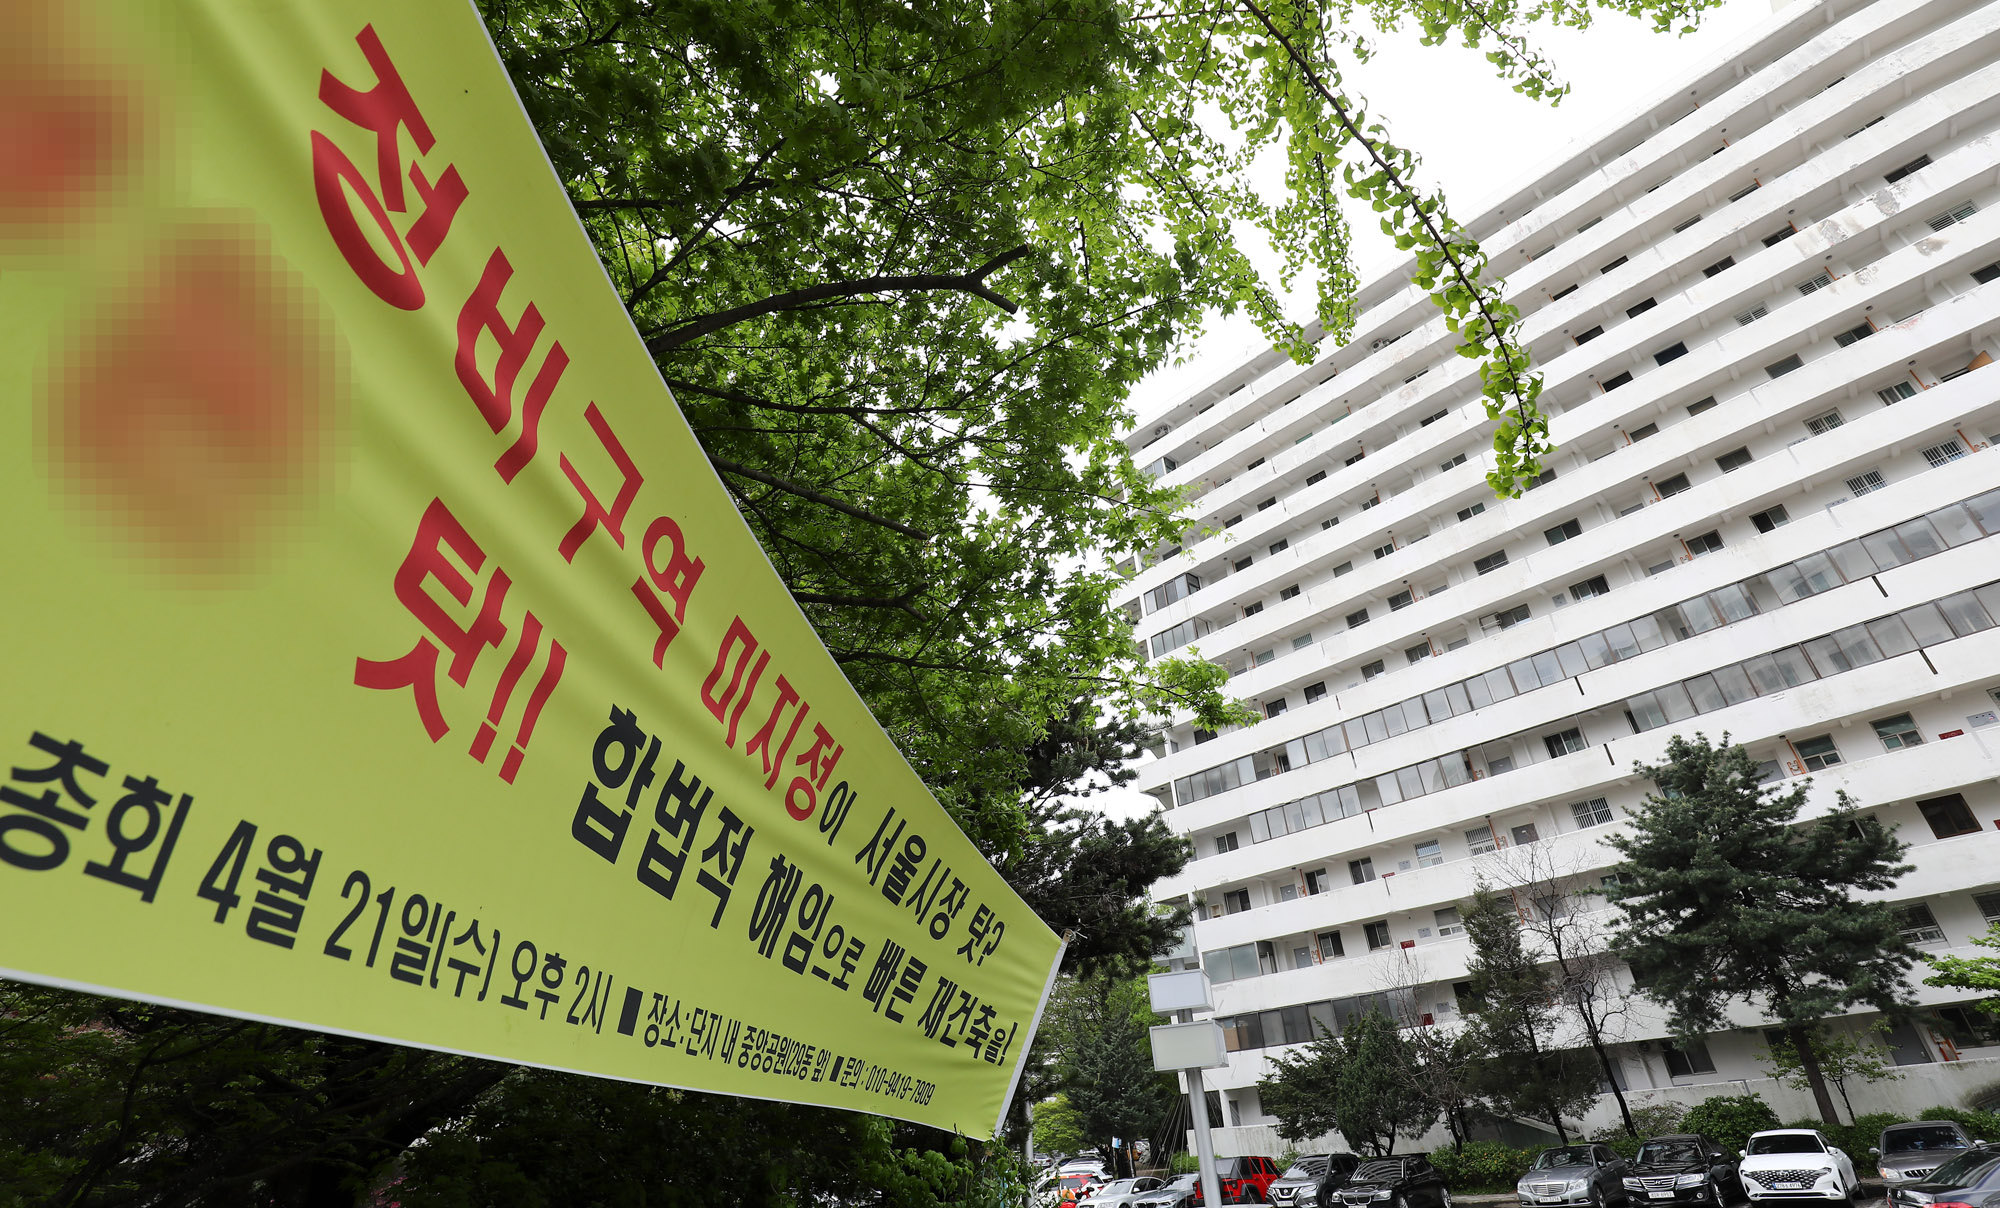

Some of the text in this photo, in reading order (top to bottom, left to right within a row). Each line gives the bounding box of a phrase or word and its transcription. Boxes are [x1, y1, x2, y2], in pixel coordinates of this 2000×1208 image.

[309, 22, 1005, 967] 정비구역 미지정이 서울시장 탓?
[0, 731, 194, 904] 총회
[196, 819, 323, 950] 4월
[323, 869, 501, 1002] 21일(수)
[500, 940, 568, 1021] 오후
[565, 965, 614, 1035] 2시
[720, 1018, 742, 1065] 내
[810, 1048, 832, 1083] 앞)
[839, 1056, 866, 1090] 문의
[353, 496, 1019, 1067] 탓!! 합법적 해임으로 빠른 재건축을!
